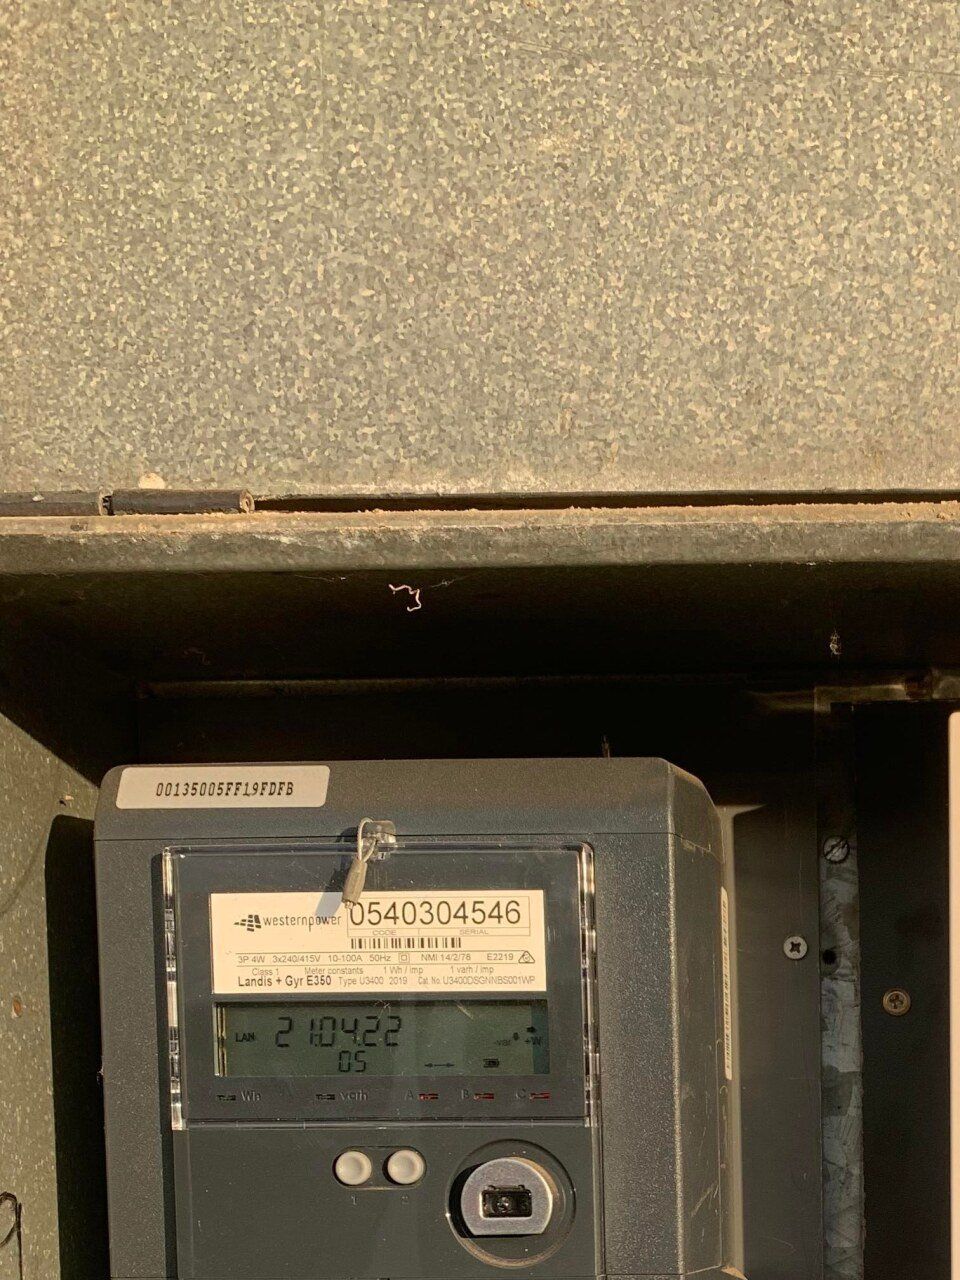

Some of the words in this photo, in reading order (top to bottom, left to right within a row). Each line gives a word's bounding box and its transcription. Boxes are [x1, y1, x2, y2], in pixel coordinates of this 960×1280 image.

[155, 781, 294, 797] 00135005FF19FDFB
[263, 915, 342, 932] westernpower
[349, 900, 522, 926] 0540304546
[238, 955, 249, 964] 3P
[252, 955, 266, 963] 4W
[272, 955, 321, 963] 3x240/415V
[328, 954, 363, 963] 10-100A
[369, 954, 392, 962] 50Hz
[421, 953, 438, 961] NMI
[486, 953, 514, 961] E2219
[252, 967, 274, 976] Class
[304, 966, 325, 975] Meter
[327, 966, 364, 975] constants
[237, 975, 273, 987] Landis
[284, 975, 304, 988] Gyr
[306, 974, 332, 985] E350
[338, 976, 357, 987] Type
[389, 976, 408, 985] 2019
[339, 1050, 367, 1072] 05
